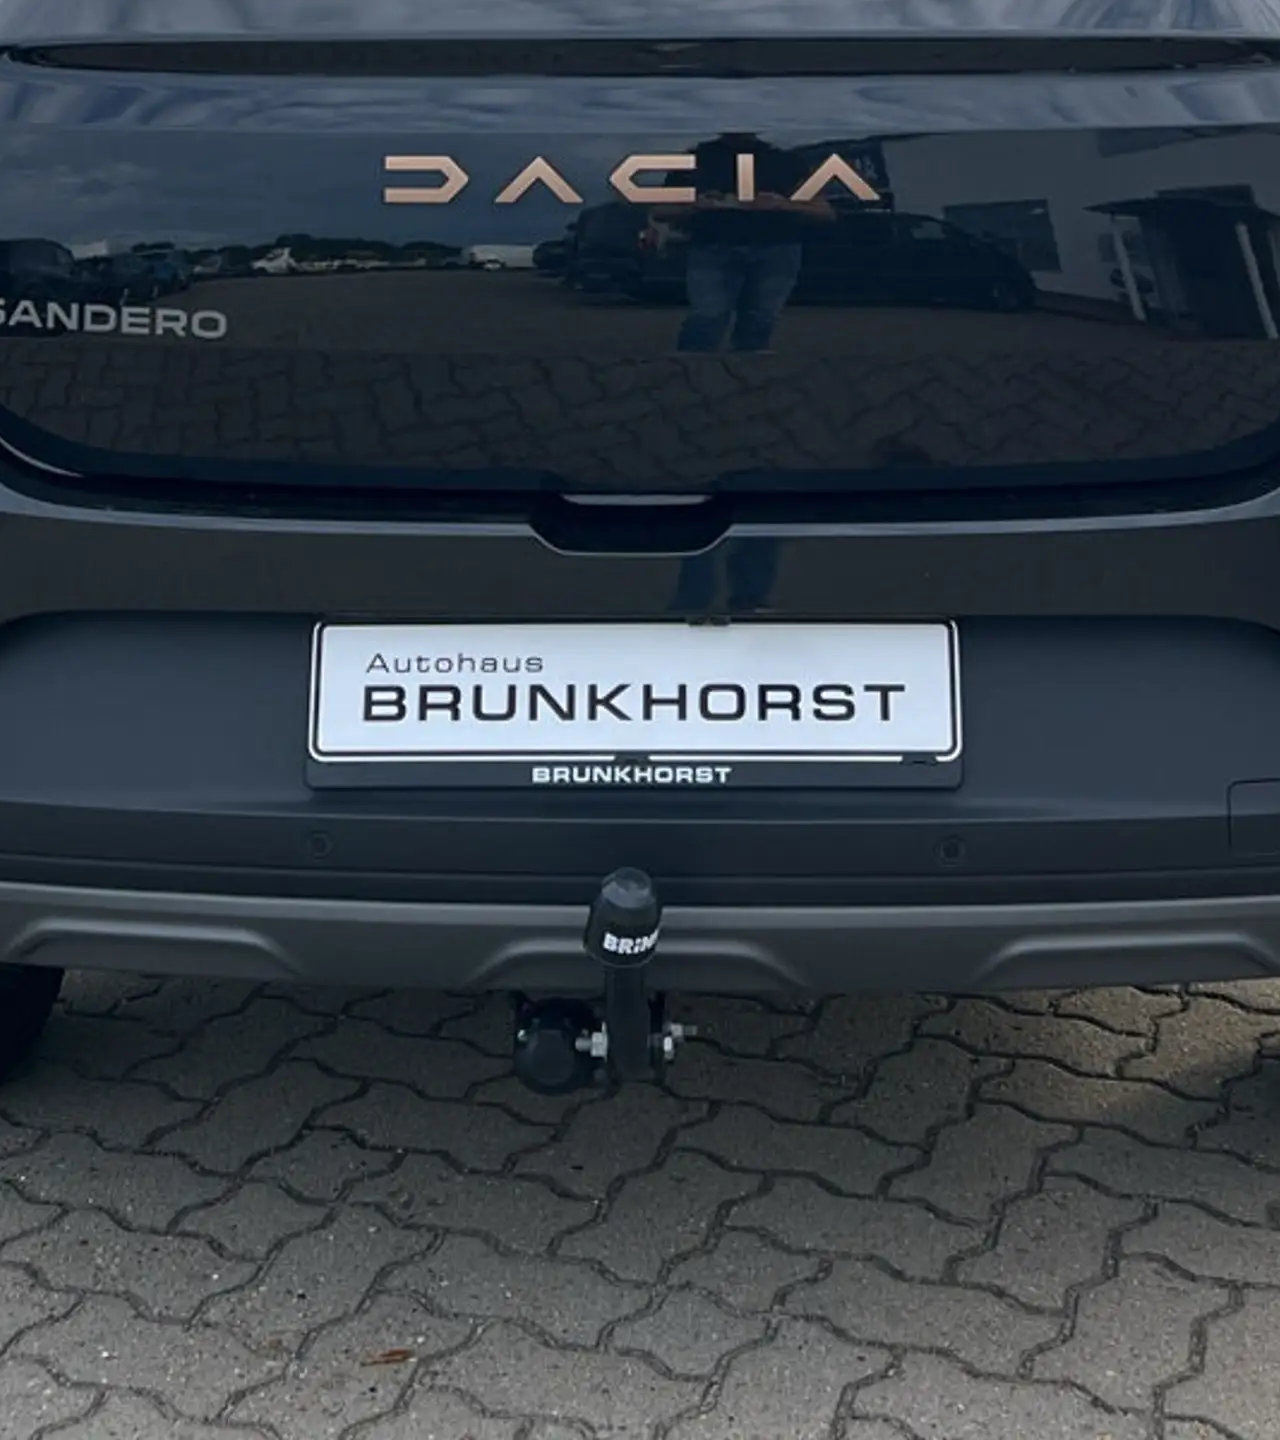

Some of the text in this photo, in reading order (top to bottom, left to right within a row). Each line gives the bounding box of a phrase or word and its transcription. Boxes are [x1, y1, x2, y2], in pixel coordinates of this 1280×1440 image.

[383, 153, 880, 204] DACIA
[365, 652, 544, 674] Autohaus
[362, 683, 906, 722] BRUNKHORST
[531, 766, 732, 784] BRUNKHORST
